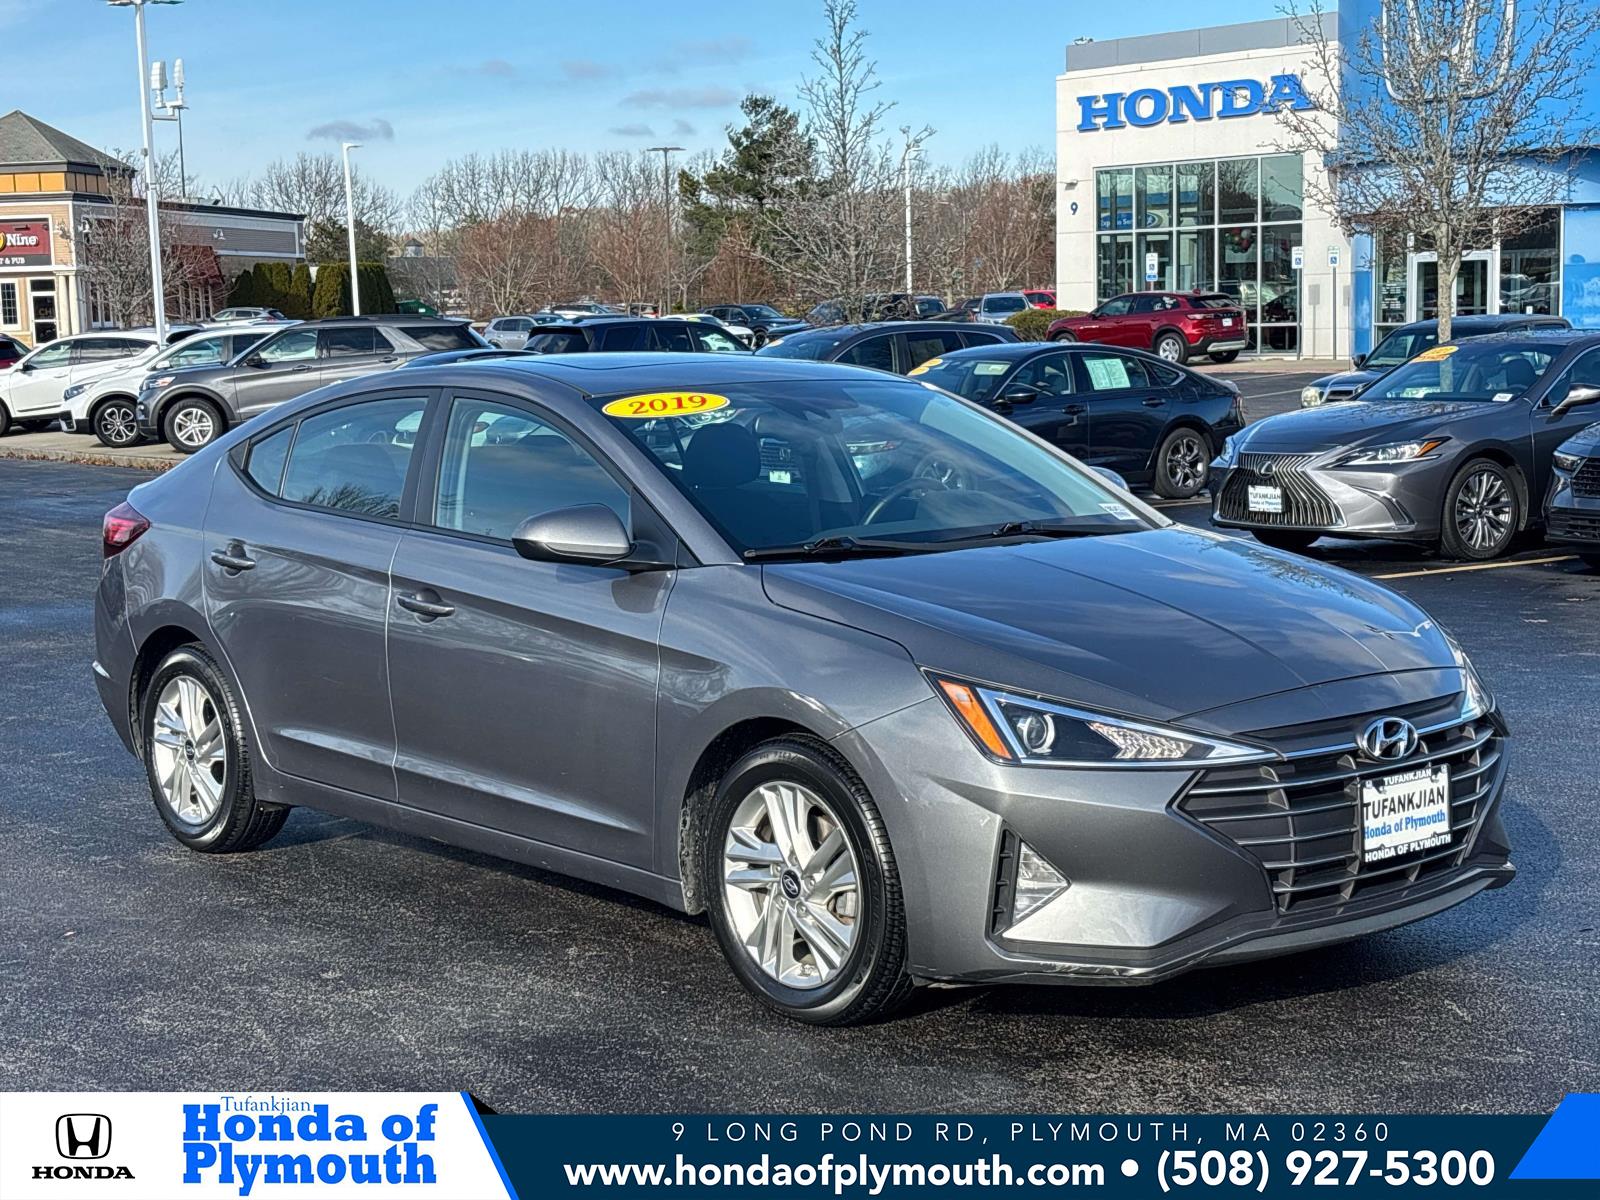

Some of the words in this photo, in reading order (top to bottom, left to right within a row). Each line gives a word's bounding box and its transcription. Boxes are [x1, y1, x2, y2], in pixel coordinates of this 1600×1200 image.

[1077, 74, 1317, 131] HONDA
[1070, 201, 1079, 216] 9
[6, 233, 38, 246] Nine
[11, 256, 26, 265] PUB
[628, 395, 708, 415] 2019
[1383, 768, 1432, 786] TUFANKJIAN
[1363, 785, 1445, 821] TUFANKJIAN
[1364, 822, 1392, 839] Honda
[1394, 819, 1403, 832] of
[1404, 809, 1446, 832] Plymouth
[1365, 846, 1396, 863] HONDA
[1397, 843, 1409, 856] OF
[1410, 833, 1452, 853] PLYMOUTH
